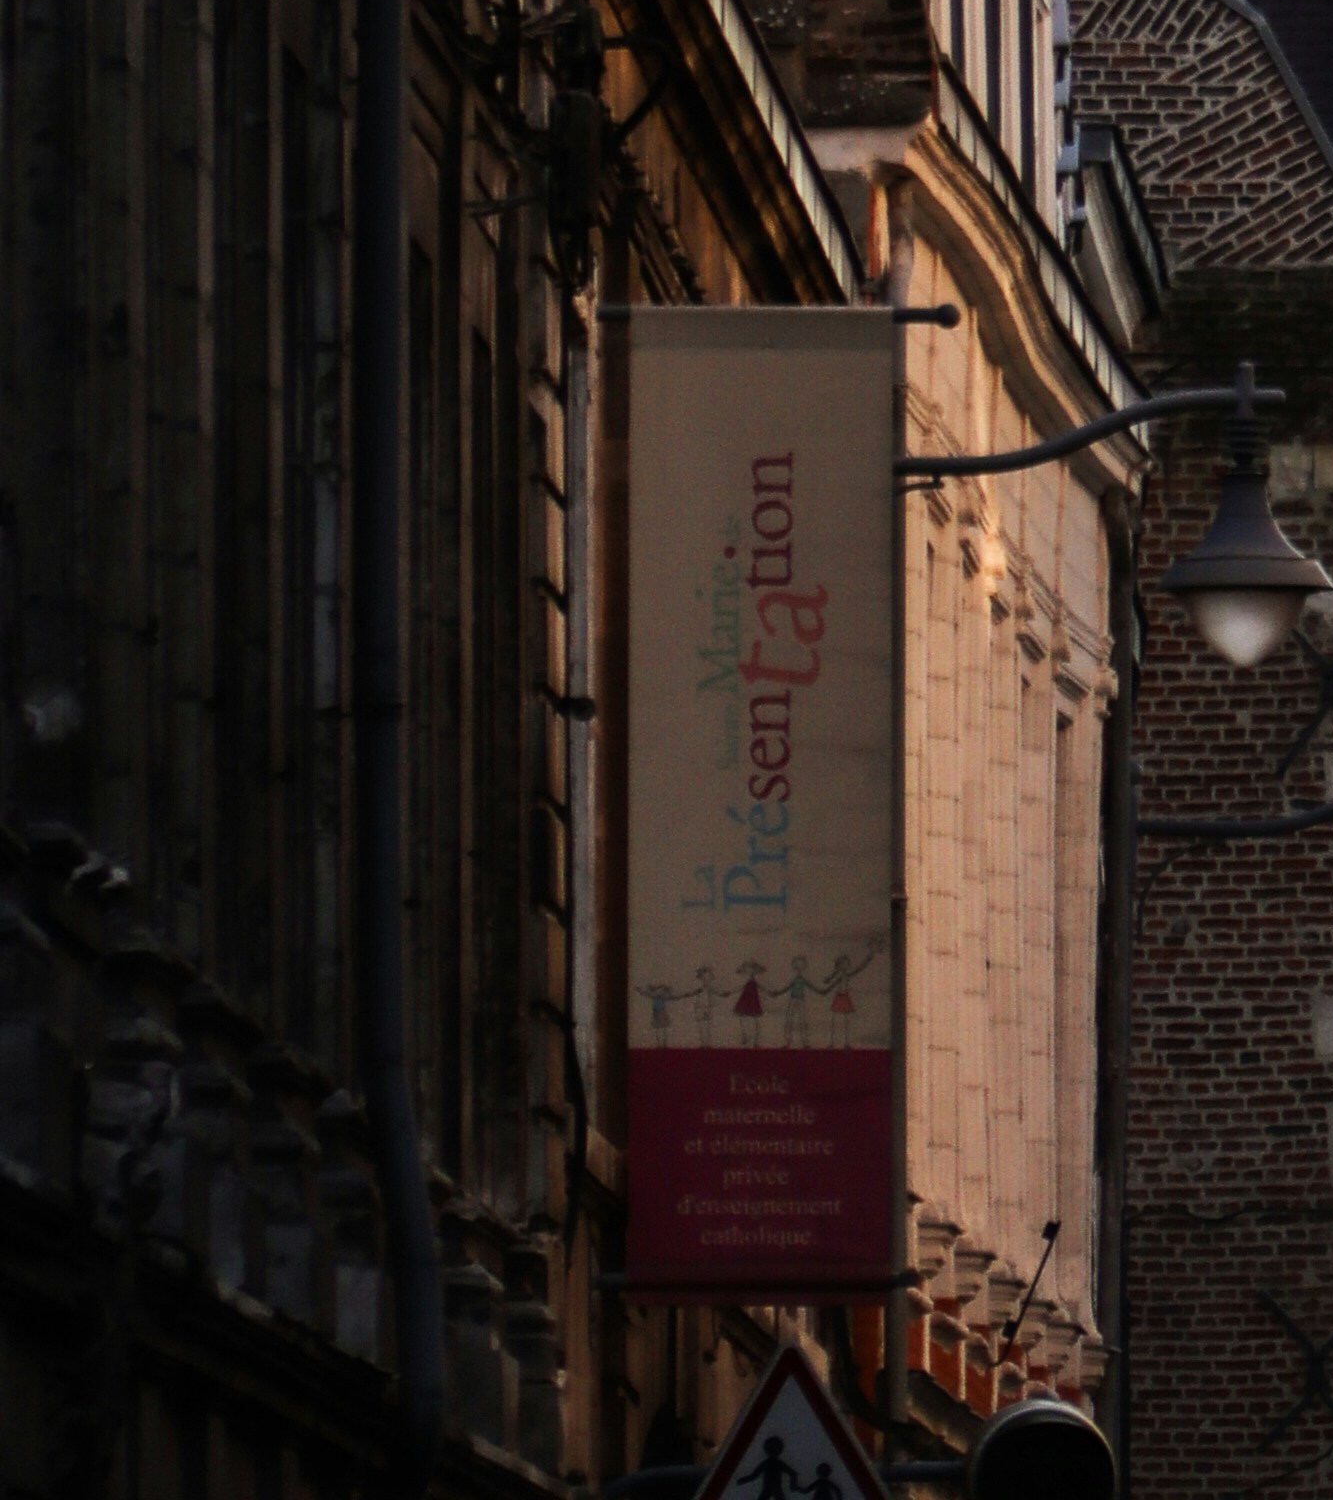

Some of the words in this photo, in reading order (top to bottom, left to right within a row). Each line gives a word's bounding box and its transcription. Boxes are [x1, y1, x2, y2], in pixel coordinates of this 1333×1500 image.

[695, 560, 740, 695] Marie
[722, 451, 829, 912] Présentation
[681, 864, 715, 911] La
[703, 1104, 817, 1125] maternelle
[683, 1138, 704, 1155] et
[709, 1133, 834, 1156] élémentaire
[722, 1166, 792, 1191] privée
[676, 1193, 841, 1220] d'enseignement
